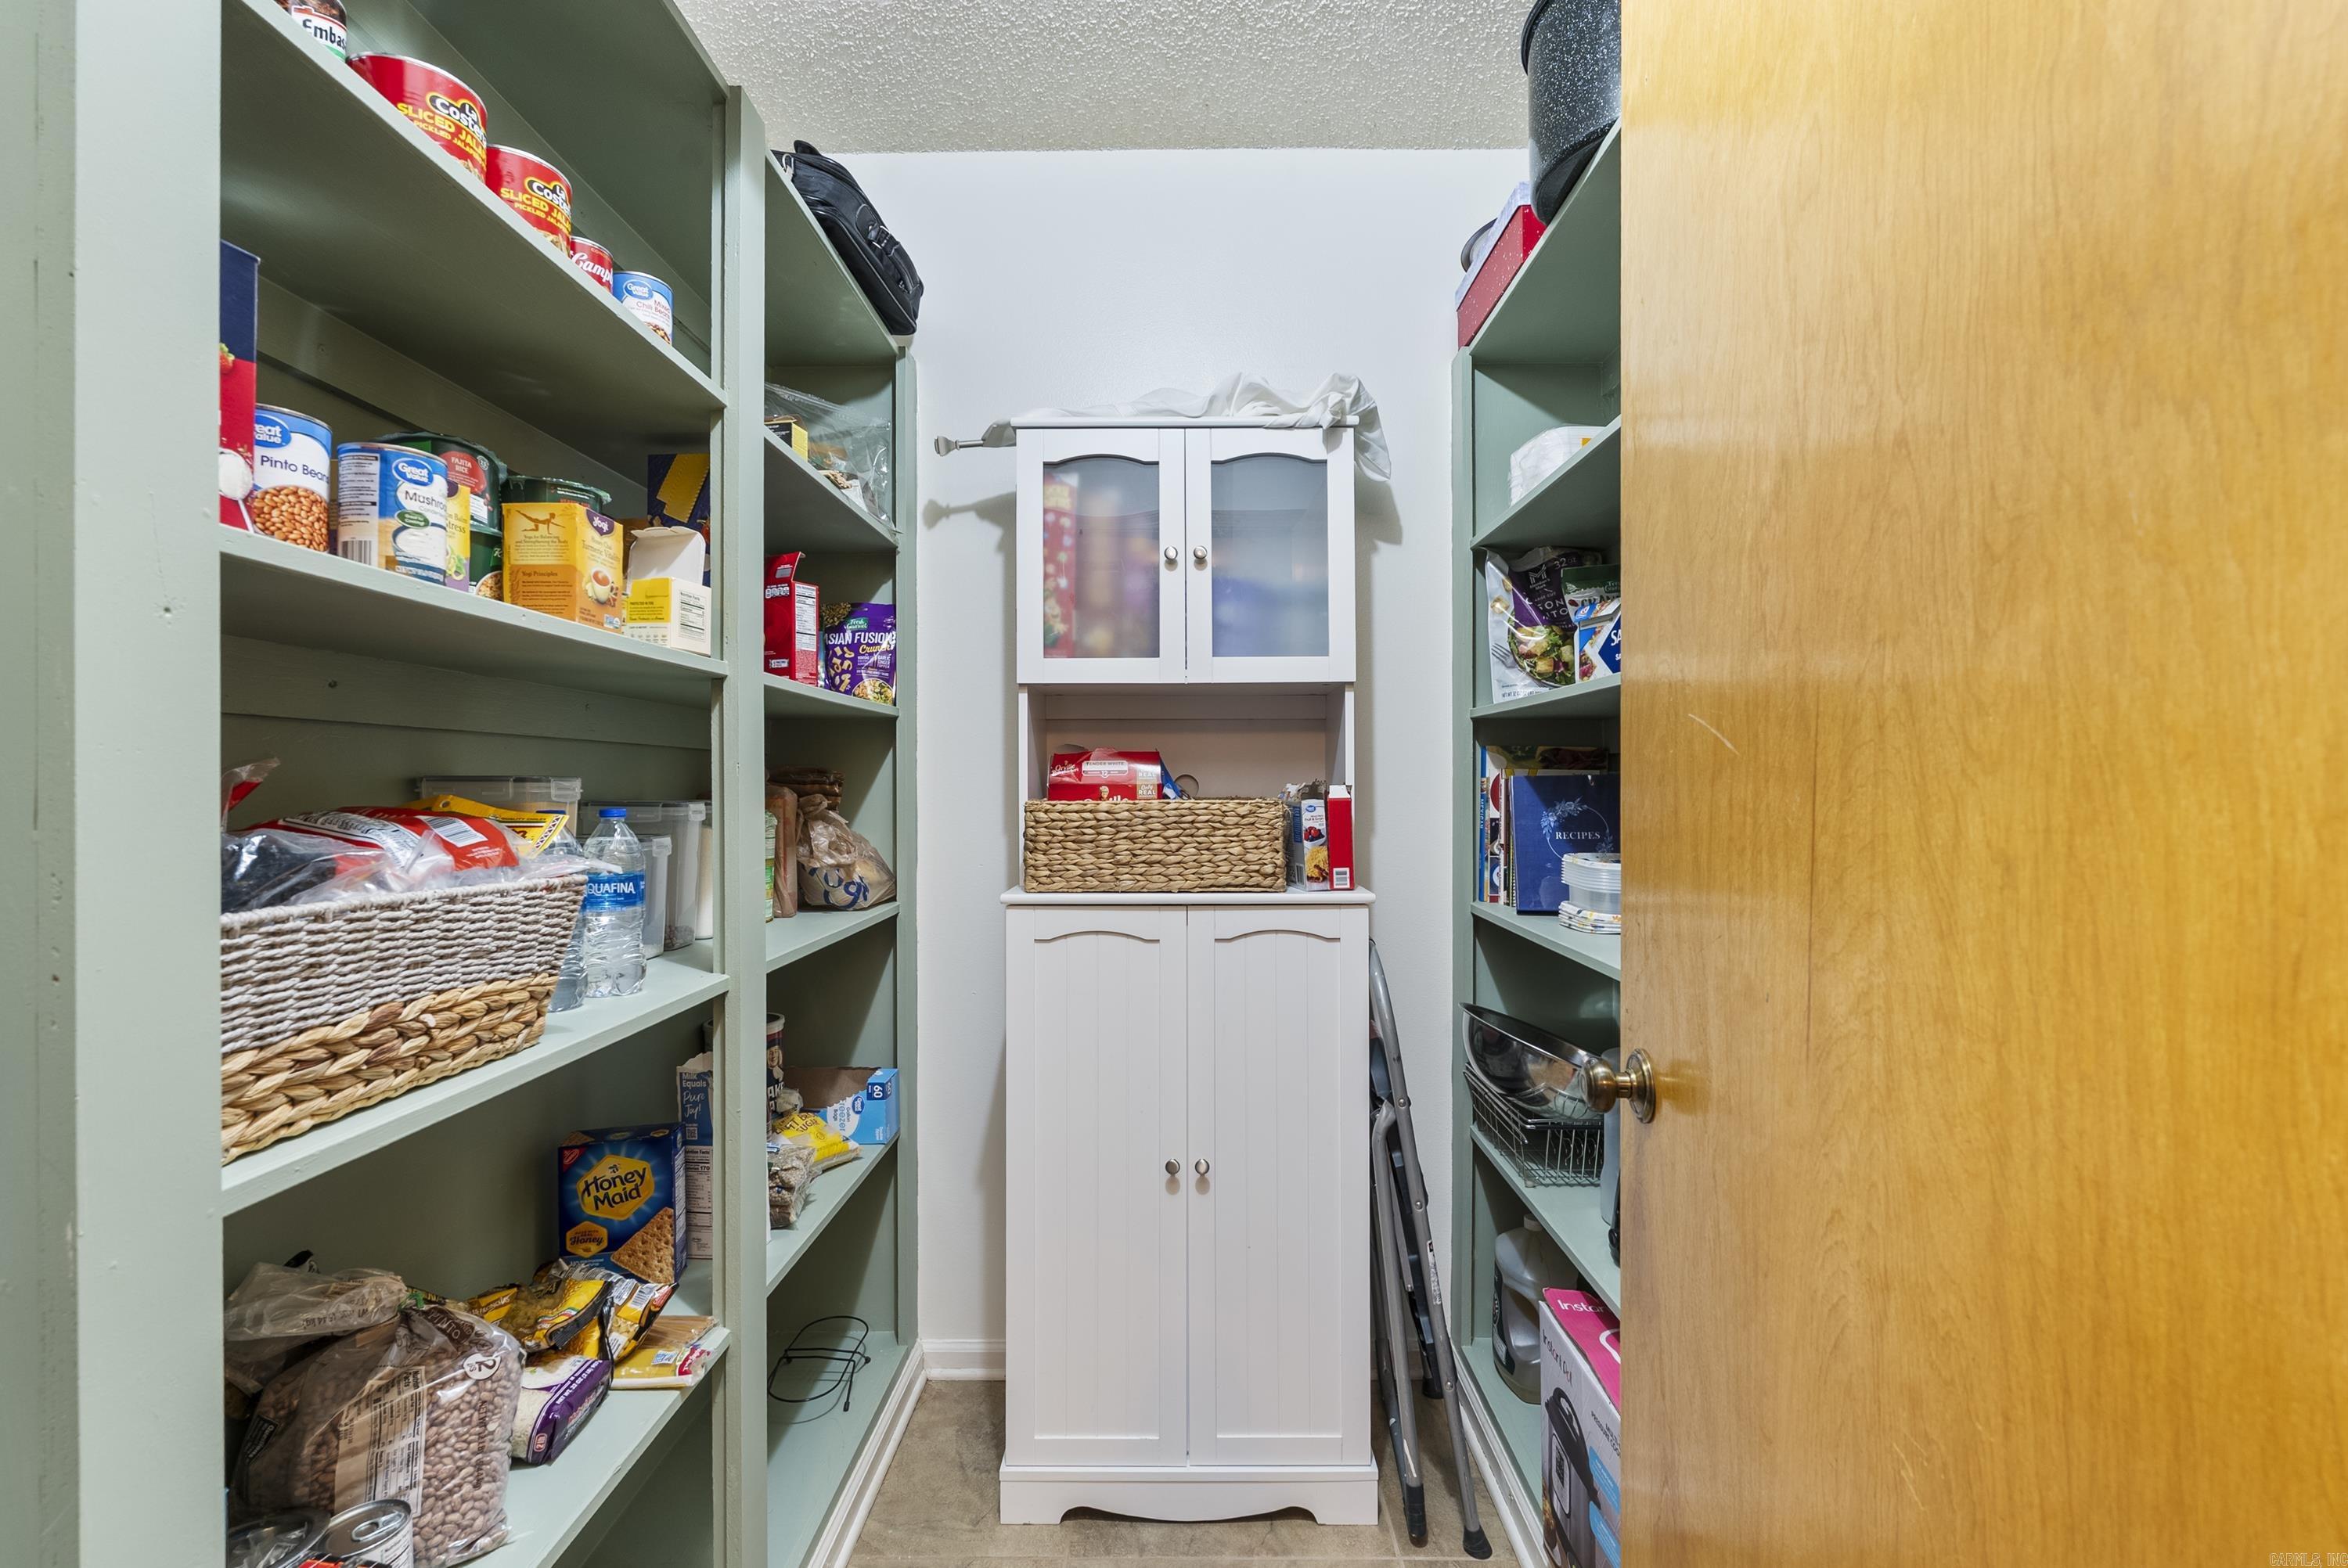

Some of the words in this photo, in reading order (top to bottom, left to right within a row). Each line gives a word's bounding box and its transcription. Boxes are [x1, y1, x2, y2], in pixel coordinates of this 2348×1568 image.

[397, 102, 455, 132] SLICED
[413, 120, 451, 139] PICKLED
[500, 187, 549, 212] SLICED
[514, 202, 546, 219] PICKLED
[627, 282, 650, 293] Great
[636, 300, 653, 311] Chili
[255, 423, 282, 437] eat
[255, 433, 283, 444] alue
[261, 455, 298, 473] Pinto
[451, 456, 473, 469] FAJITA
[456, 465, 470, 474] RICE
[398, 462, 429, 479] Great
[1554, 558, 1567, 570] 32
[587, 882, 636, 897] QUAFINA
[682, 1080, 707, 1089] Equals
[873, 1085, 884, 1098] 60
[682, 1090, 705, 1104] Pure
[582, 1167, 646, 1201] Honey
[593, 1184, 642, 1210] Maid
[570, 1235, 604, 1246] Honey
[428, 1310, 462, 1340] PINTO
[477, 1358, 496, 1372] 2
